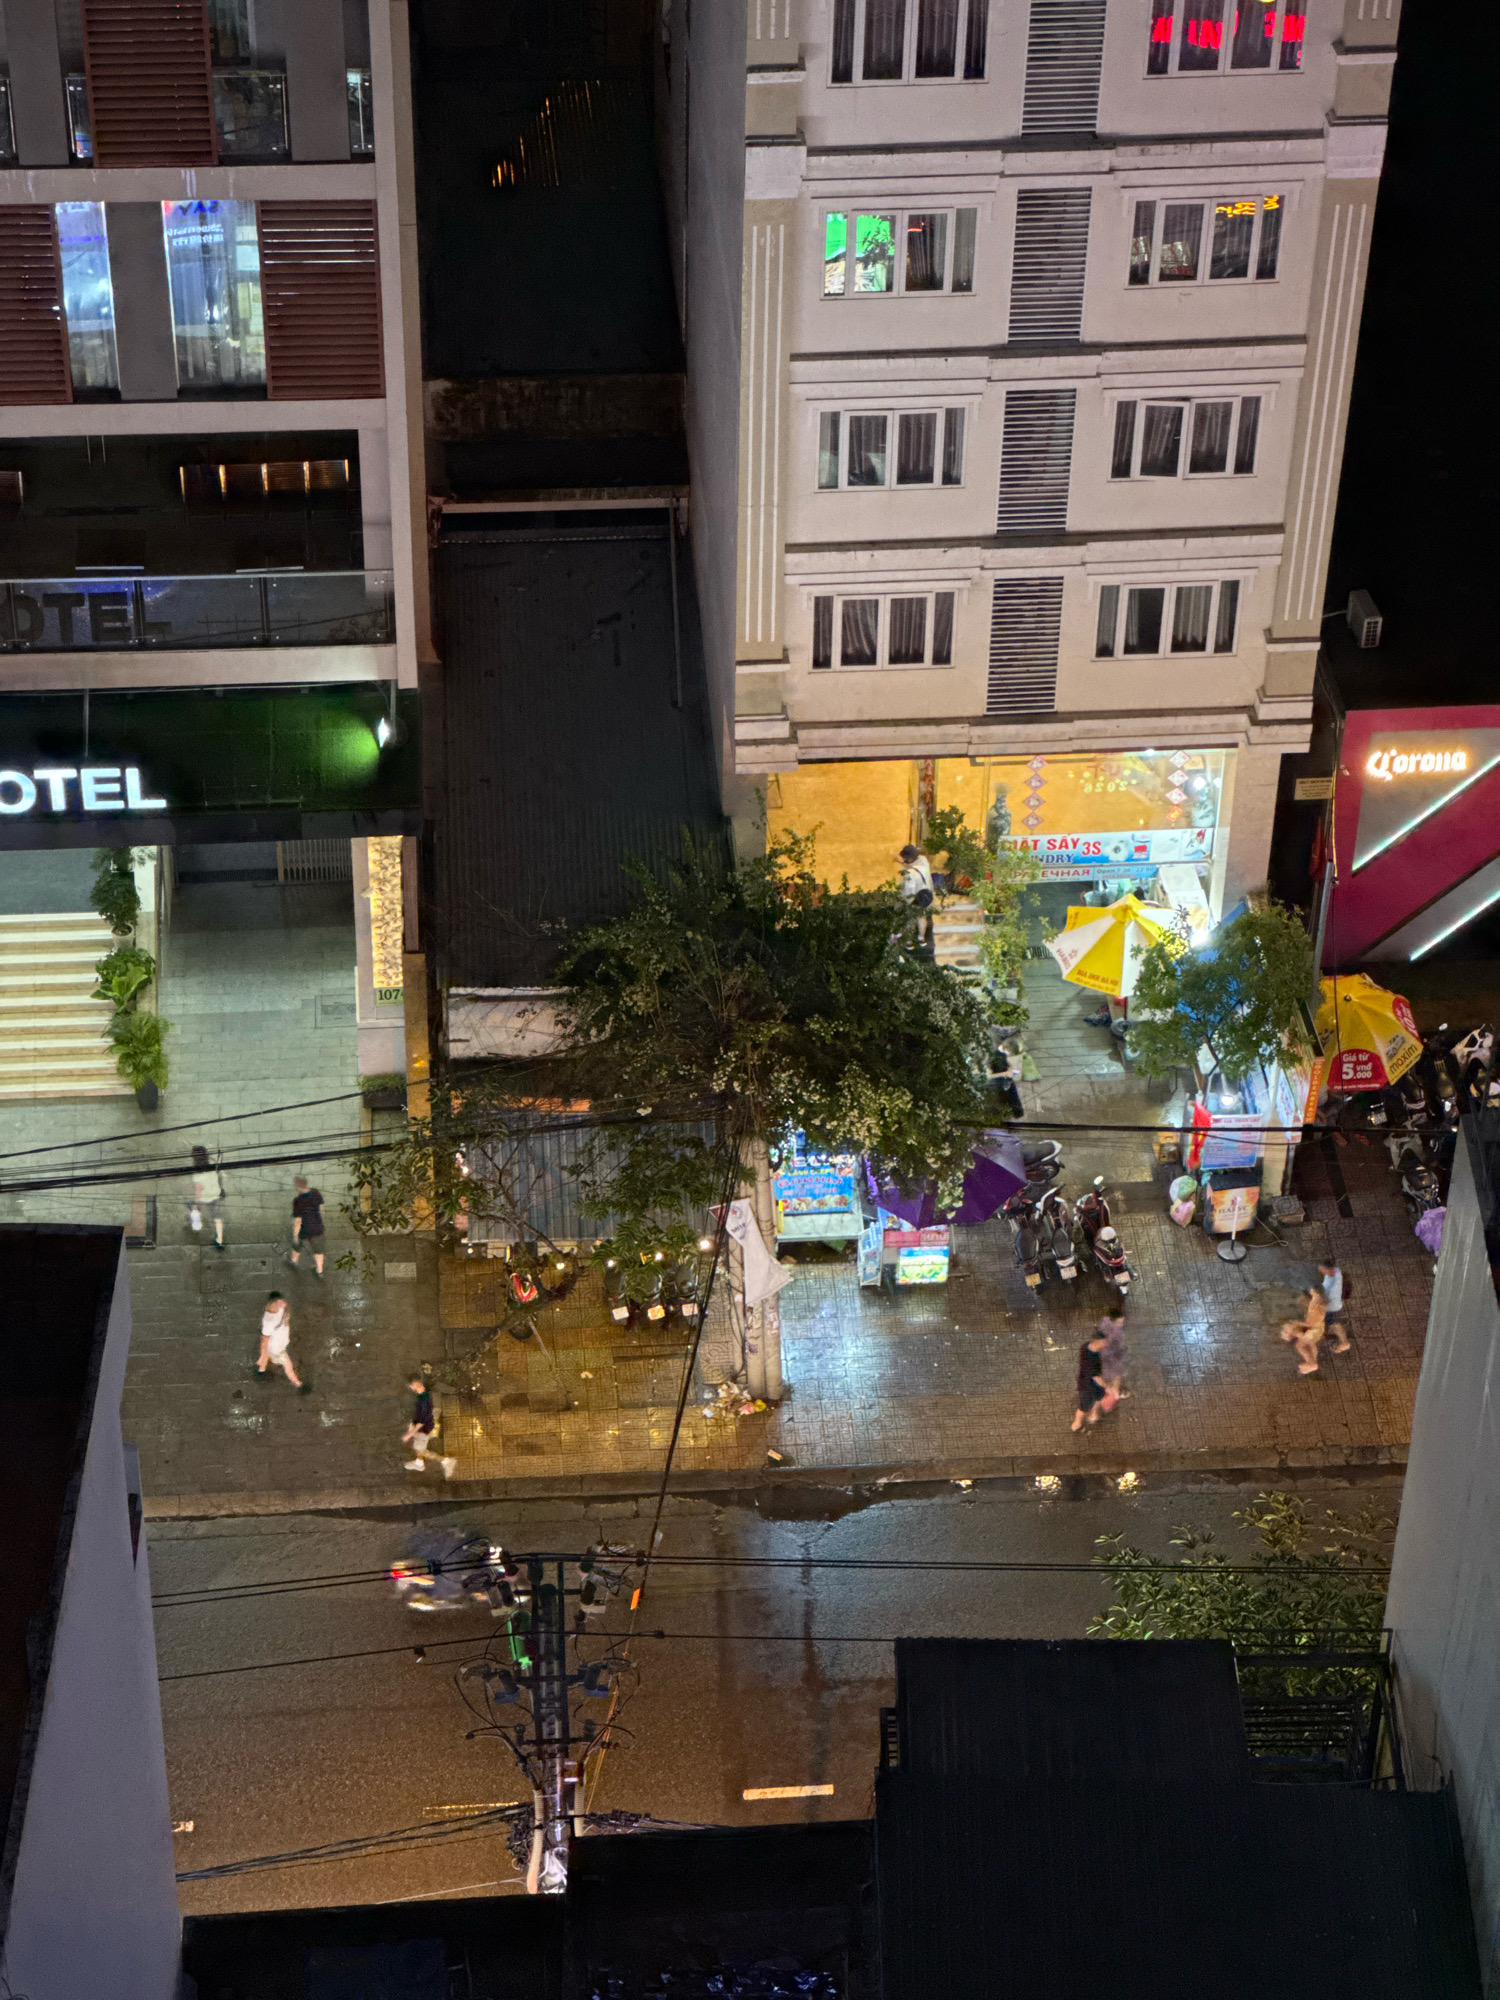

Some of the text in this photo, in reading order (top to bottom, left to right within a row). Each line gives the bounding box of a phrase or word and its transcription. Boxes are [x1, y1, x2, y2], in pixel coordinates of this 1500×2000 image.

[1364, 748, 1469, 781] Corona
[0, 767, 167, 814] OTEL
[1081, 841, 1102, 856] 3S
[378, 989, 404, 1001] 107
[1342, 1052, 1370, 1062] Giá từ
[1389, 1043, 1418, 1075] maxim
